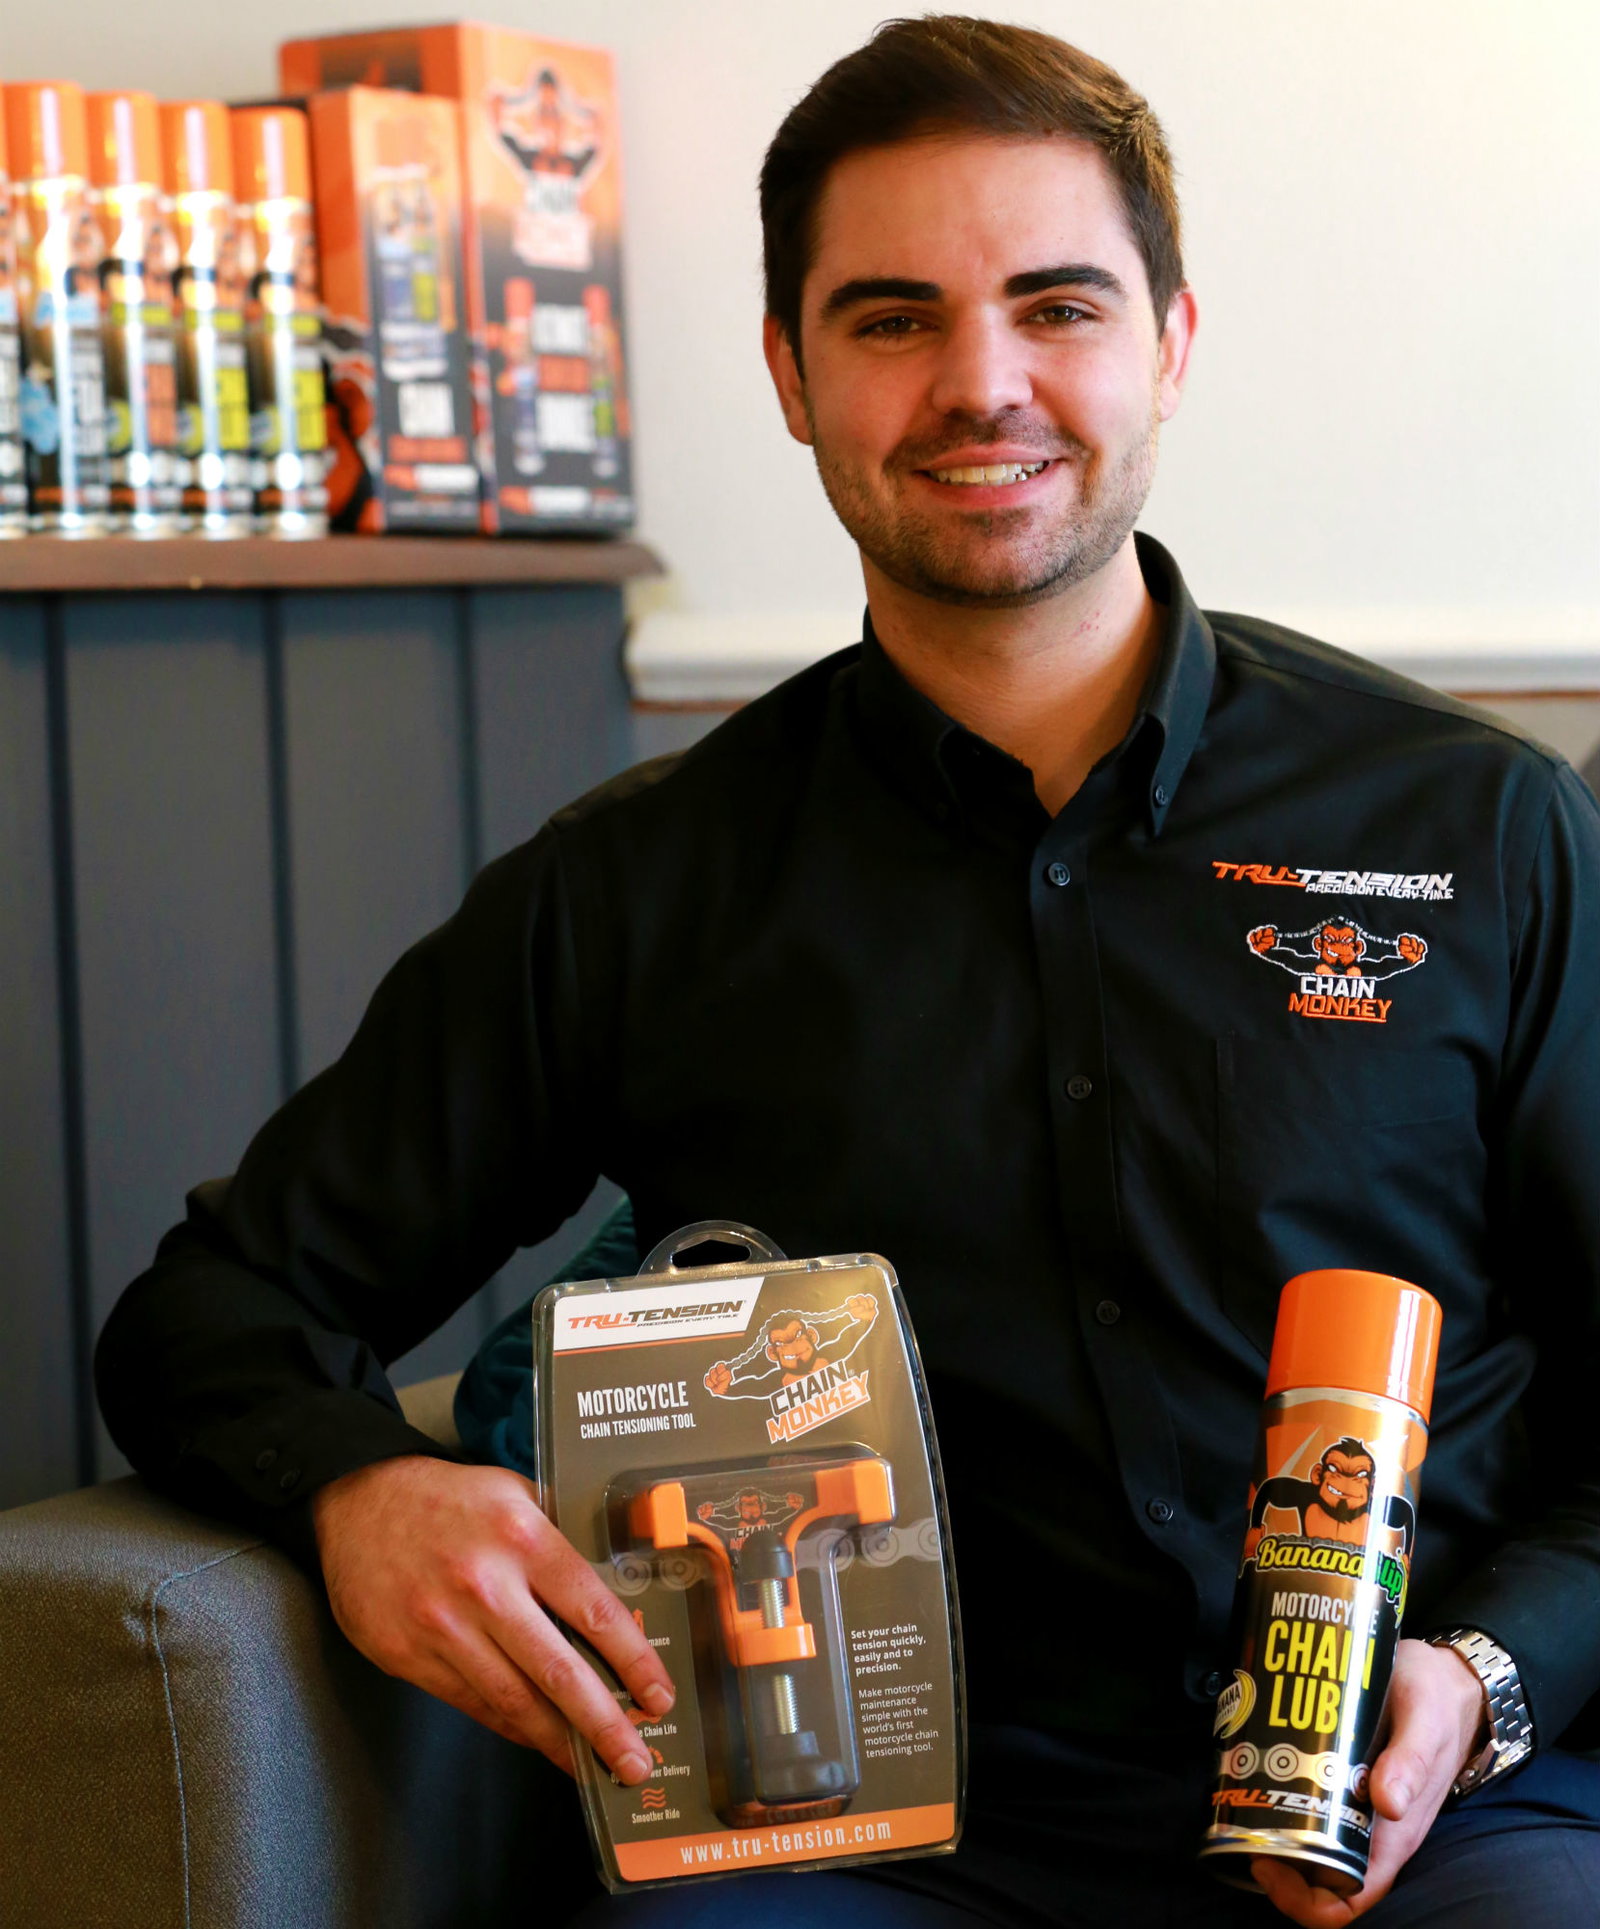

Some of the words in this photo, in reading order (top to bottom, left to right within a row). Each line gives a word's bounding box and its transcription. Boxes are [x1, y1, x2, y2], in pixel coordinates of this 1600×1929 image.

[1212, 861, 1453, 890] TRU-TENSION
[1305, 883, 1375, 896] PRECISION
[1300, 976, 1375, 999] CHAIN
[1288, 992, 1393, 1021] MONKEY
[568, 1300, 744, 1329] TRU-TENSION
[770, 1360, 849, 1417] CHAIN
[577, 1381, 689, 1417] MOTORCYCLE
[766, 1370, 871, 1444] MONKEY
[580, 1421, 611, 1439] CHAIN
[612, 1415, 670, 1435] TENSIONING
[671, 1413, 696, 1429] TOOL
[1374, 1553, 1403, 1599] lip
[1271, 1592, 1380, 1635] MOTORCYE
[851, 1629, 866, 1639] Set
[868, 1628, 889, 1640] your
[892, 1623, 917, 1635] chain
[853, 1640, 887, 1651] tension
[890, 1635, 927, 1648] quickly,
[854, 1651, 881, 1663] easily
[883, 1650, 901, 1660] and
[903, 1648, 913, 1657] to
[855, 1662, 901, 1677] precision.
[859, 1689, 882, 1699] Make
[884, 1681, 933, 1695] motorcycle
[860, 1697, 917, 1711] maintenance
[1269, 1675, 1355, 1741] LUB
[861, 1711, 891, 1723] simple
[893, 1708, 912, 1718] with
[914, 1706, 928, 1715] the
[644, 1725, 663, 1737] Chain
[664, 1723, 677, 1735] Life
[863, 1722, 895, 1735] world's
[896, 1720, 914, 1730] first
[865, 1732, 913, 1746] motorcycle
[915, 1729, 939, 1739] chain
[866, 1745, 913, 1759] tensioning
[914, 1742, 934, 1753] tool.
[650, 1769, 662, 1778] wer
[663, 1765, 690, 1777] Delivery
[632, 1810, 664, 1824] Smoother
[665, 1808, 680, 1819] Ride
[680, 1821, 892, 1864] www.tru-tension.com
